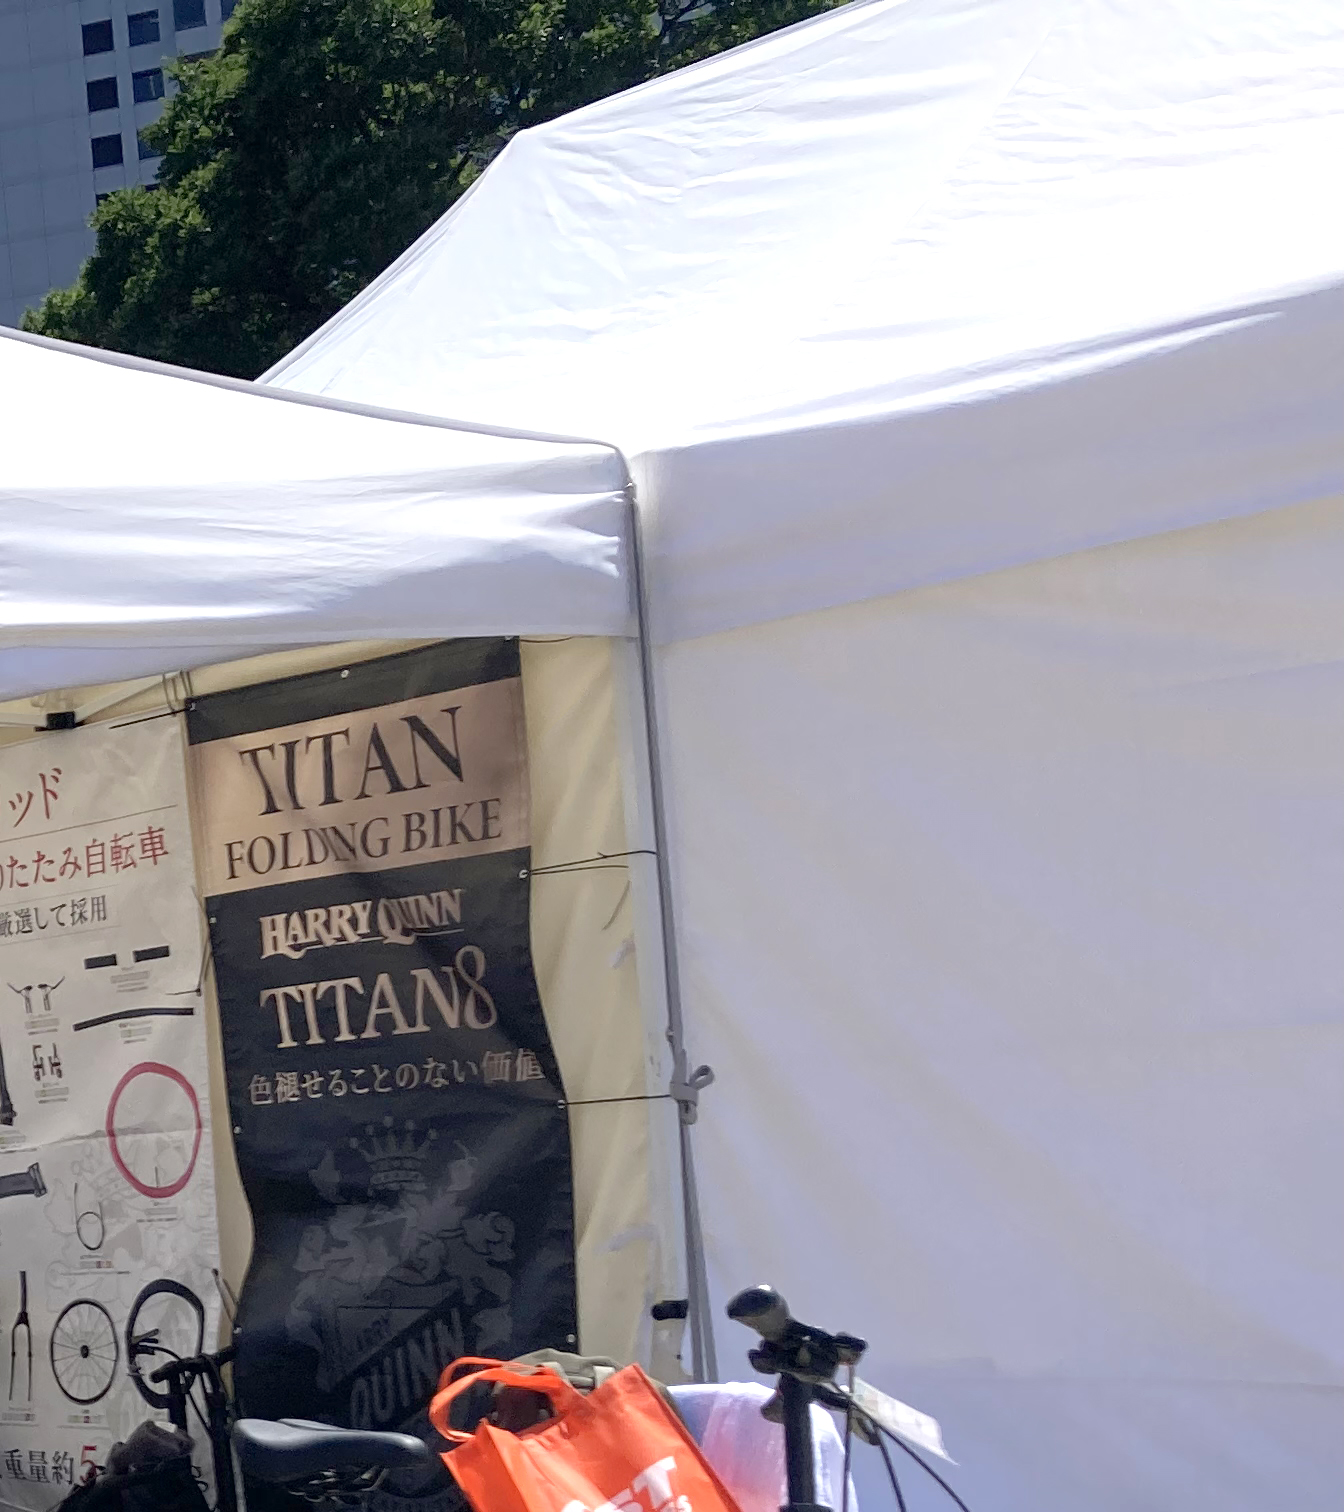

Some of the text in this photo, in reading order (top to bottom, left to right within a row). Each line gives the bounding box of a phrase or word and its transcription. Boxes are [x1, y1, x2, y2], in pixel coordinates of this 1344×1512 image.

[239, 706, 464, 816] TITAN
[225, 798, 503, 879] FOLDING BIKE
[259, 888, 465, 959] HARRY QUINN
[248, 1048, 546, 1105] 色褪せることのない価値
